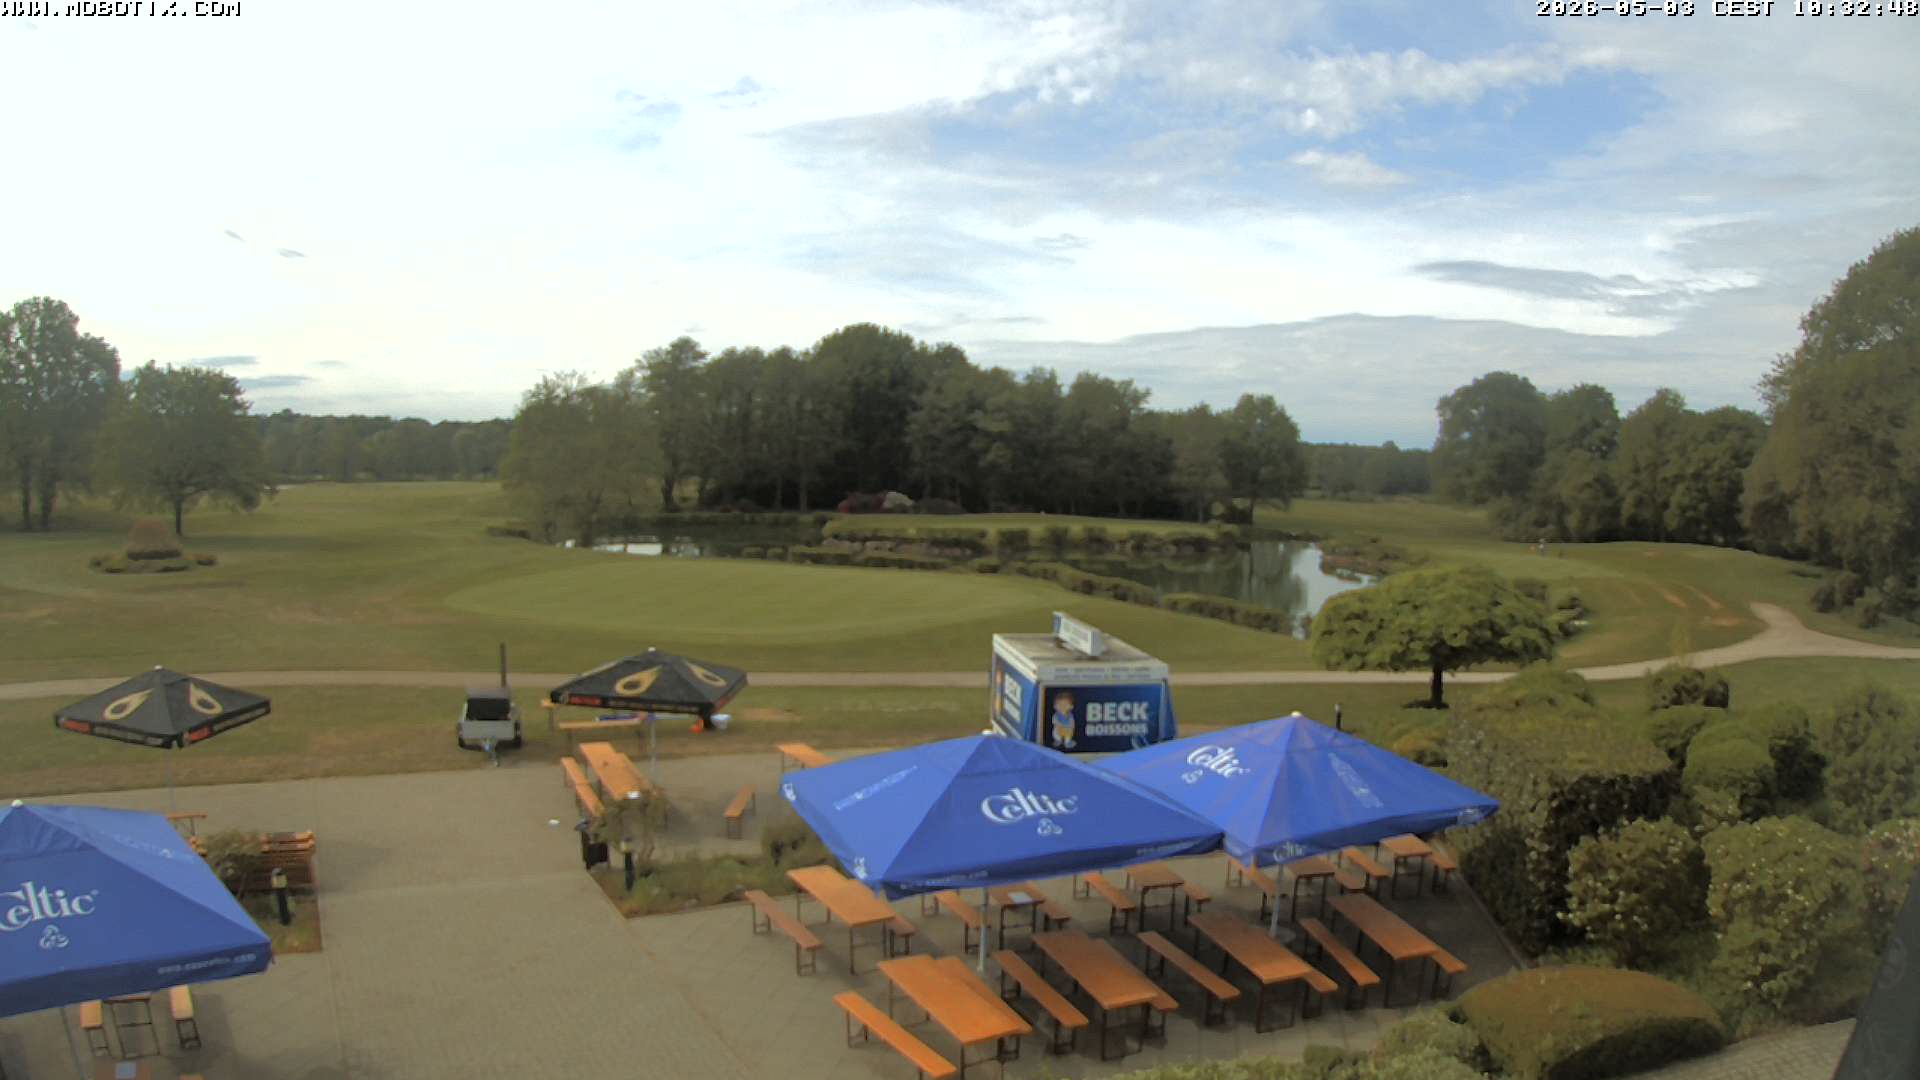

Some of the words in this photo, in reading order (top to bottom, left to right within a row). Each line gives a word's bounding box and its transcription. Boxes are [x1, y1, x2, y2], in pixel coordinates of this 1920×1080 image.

[1085, 702, 1149, 721] BECK
[1085, 723, 1149, 736] BOISSONS
[1186, 745, 1248, 778] Celtic
[981, 787, 1076, 823] Celtic
